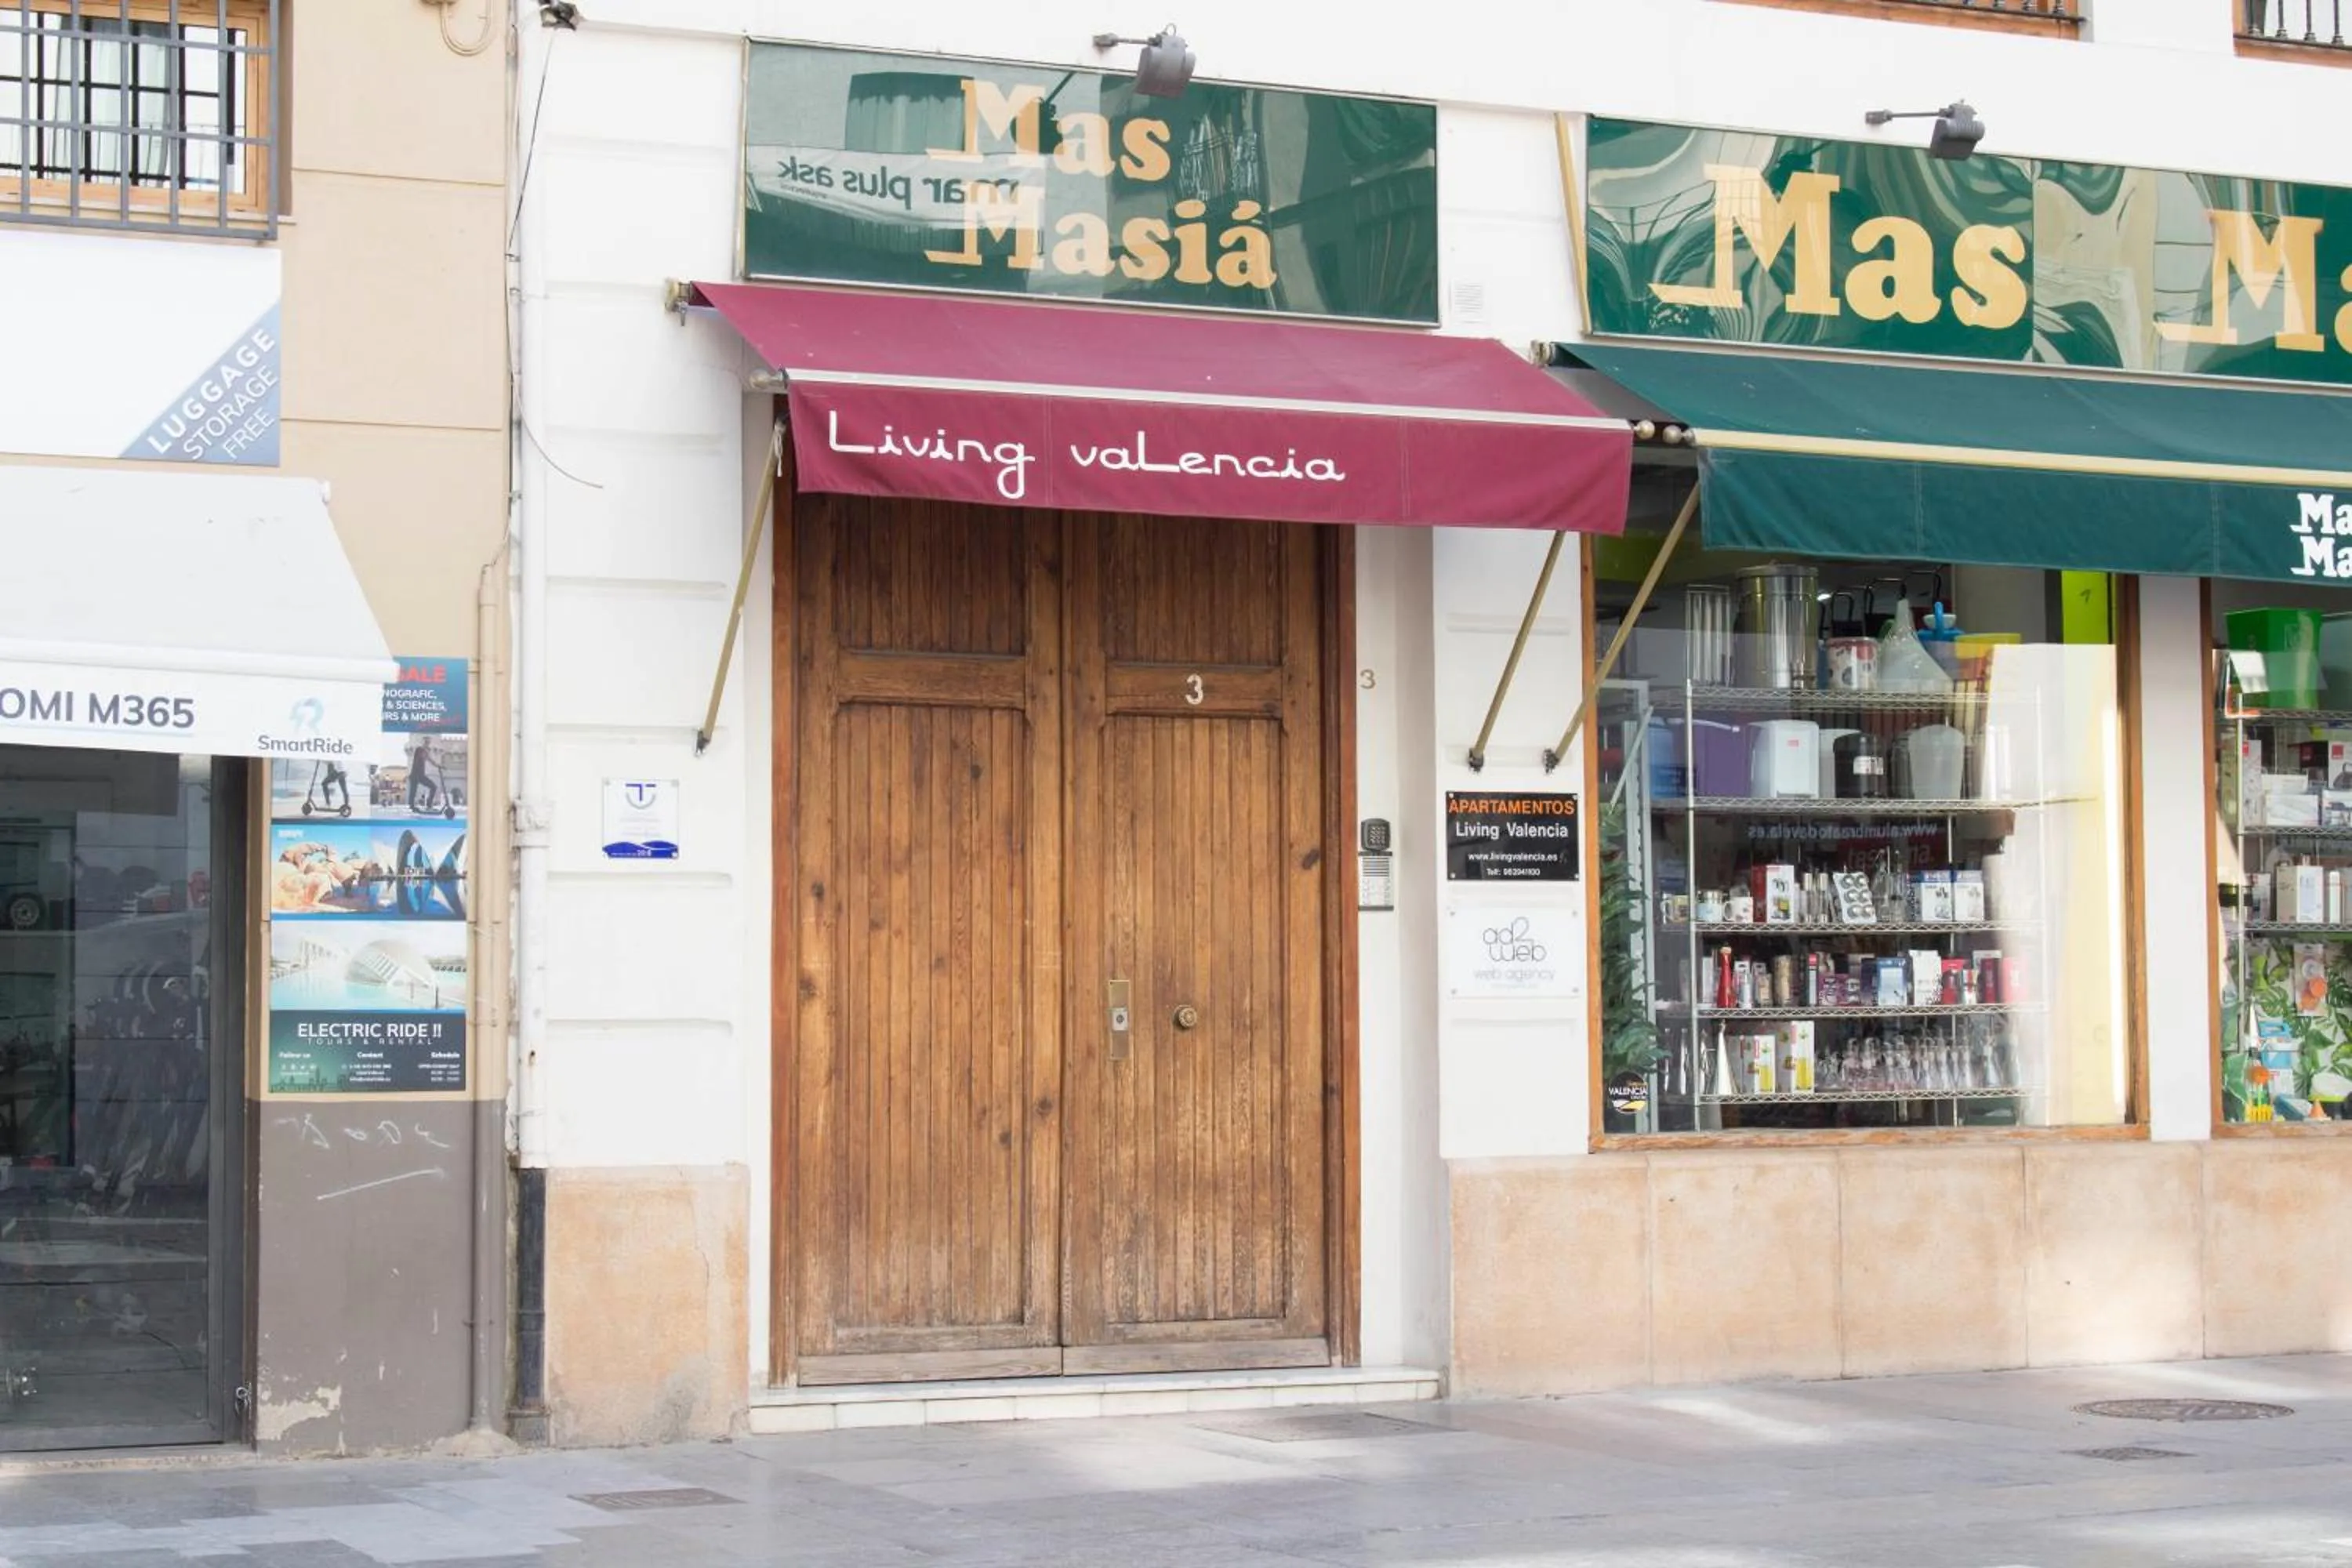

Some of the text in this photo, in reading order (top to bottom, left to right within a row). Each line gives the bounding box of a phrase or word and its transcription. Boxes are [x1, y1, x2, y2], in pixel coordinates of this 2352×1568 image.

[925, 78, 1171, 182] Mas
[924, 183, 1277, 289] Masiá
[1647, 163, 2028, 330] Mas
[2153, 209, 2352, 354] M
[147, 328, 275, 455] LUGGAGE
[183, 365, 278, 460] STORAGE
[222, 406, 275, 459] FREE
[829, 410, 1035, 499] Living
[1185, 673, 1203, 705] 3
[1359, 669, 1376, 689] 3
[0, 688, 194, 728] OMI M365
[411, 712, 440, 722] MORE
[257, 735, 353, 755] SmartRide
[1449, 799, 1575, 815] APARTAMENTOS
[1455, 822, 1569, 840] Living Valencia
[1468, 852, 1558, 863] www.livingvalencia.es
[297, 1023, 382, 1038] ELECTRIC
[387, 1024, 428, 1038] RIDE
